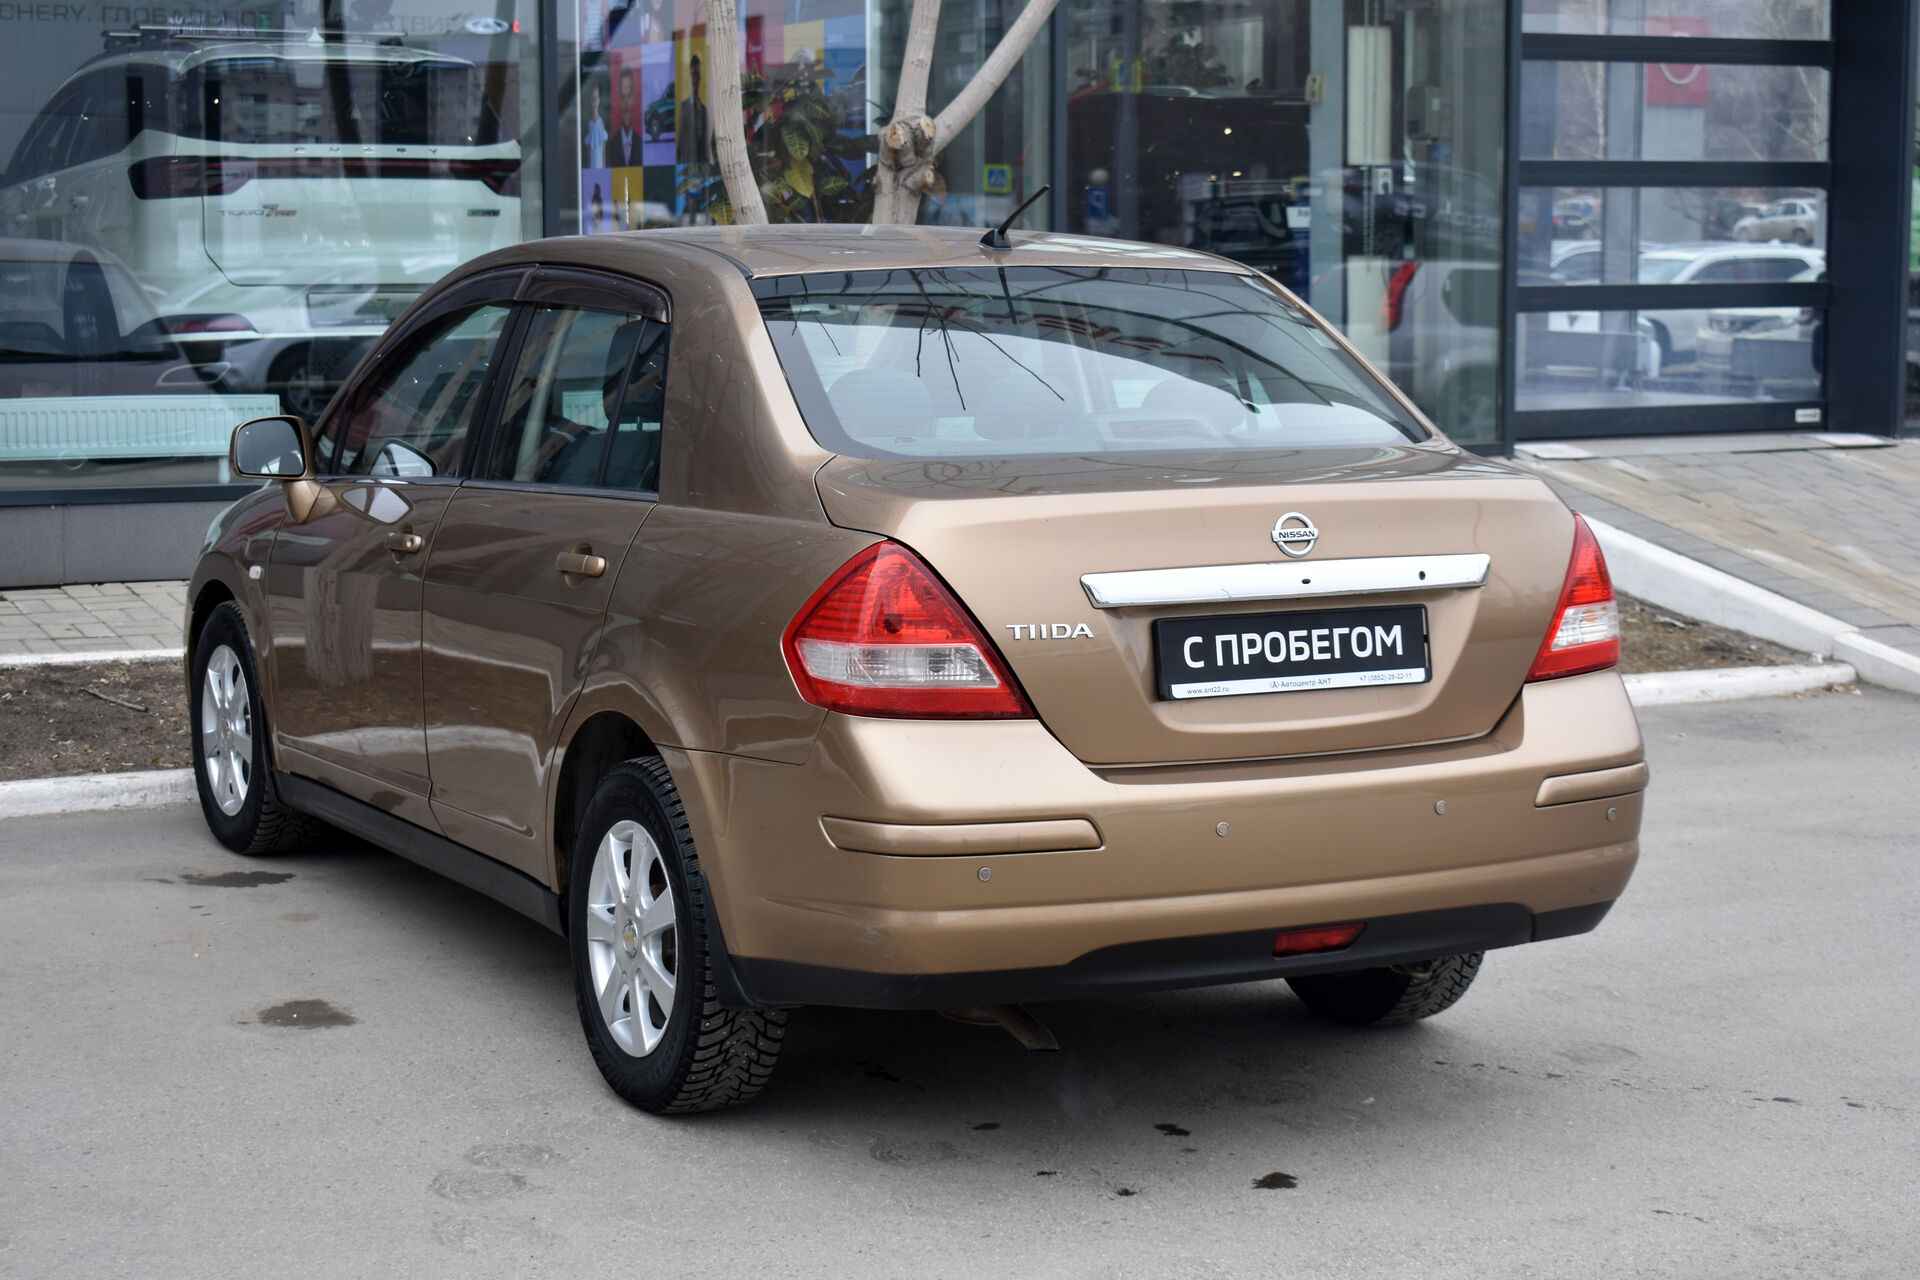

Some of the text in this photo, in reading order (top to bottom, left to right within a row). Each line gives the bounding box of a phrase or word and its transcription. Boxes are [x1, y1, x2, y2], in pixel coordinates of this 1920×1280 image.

[1278, 530, 1315, 539] NISSAN
[1006, 623, 1094, 640] TIIDA
[1183, 624, 1404, 669] С ПРОБЕГОМ
[1281, 680, 1317, 688] Автоцентр
[1317, 677, 1331, 686] АНТ
[1186, 686, 1230, 695] www.ant22.ru
